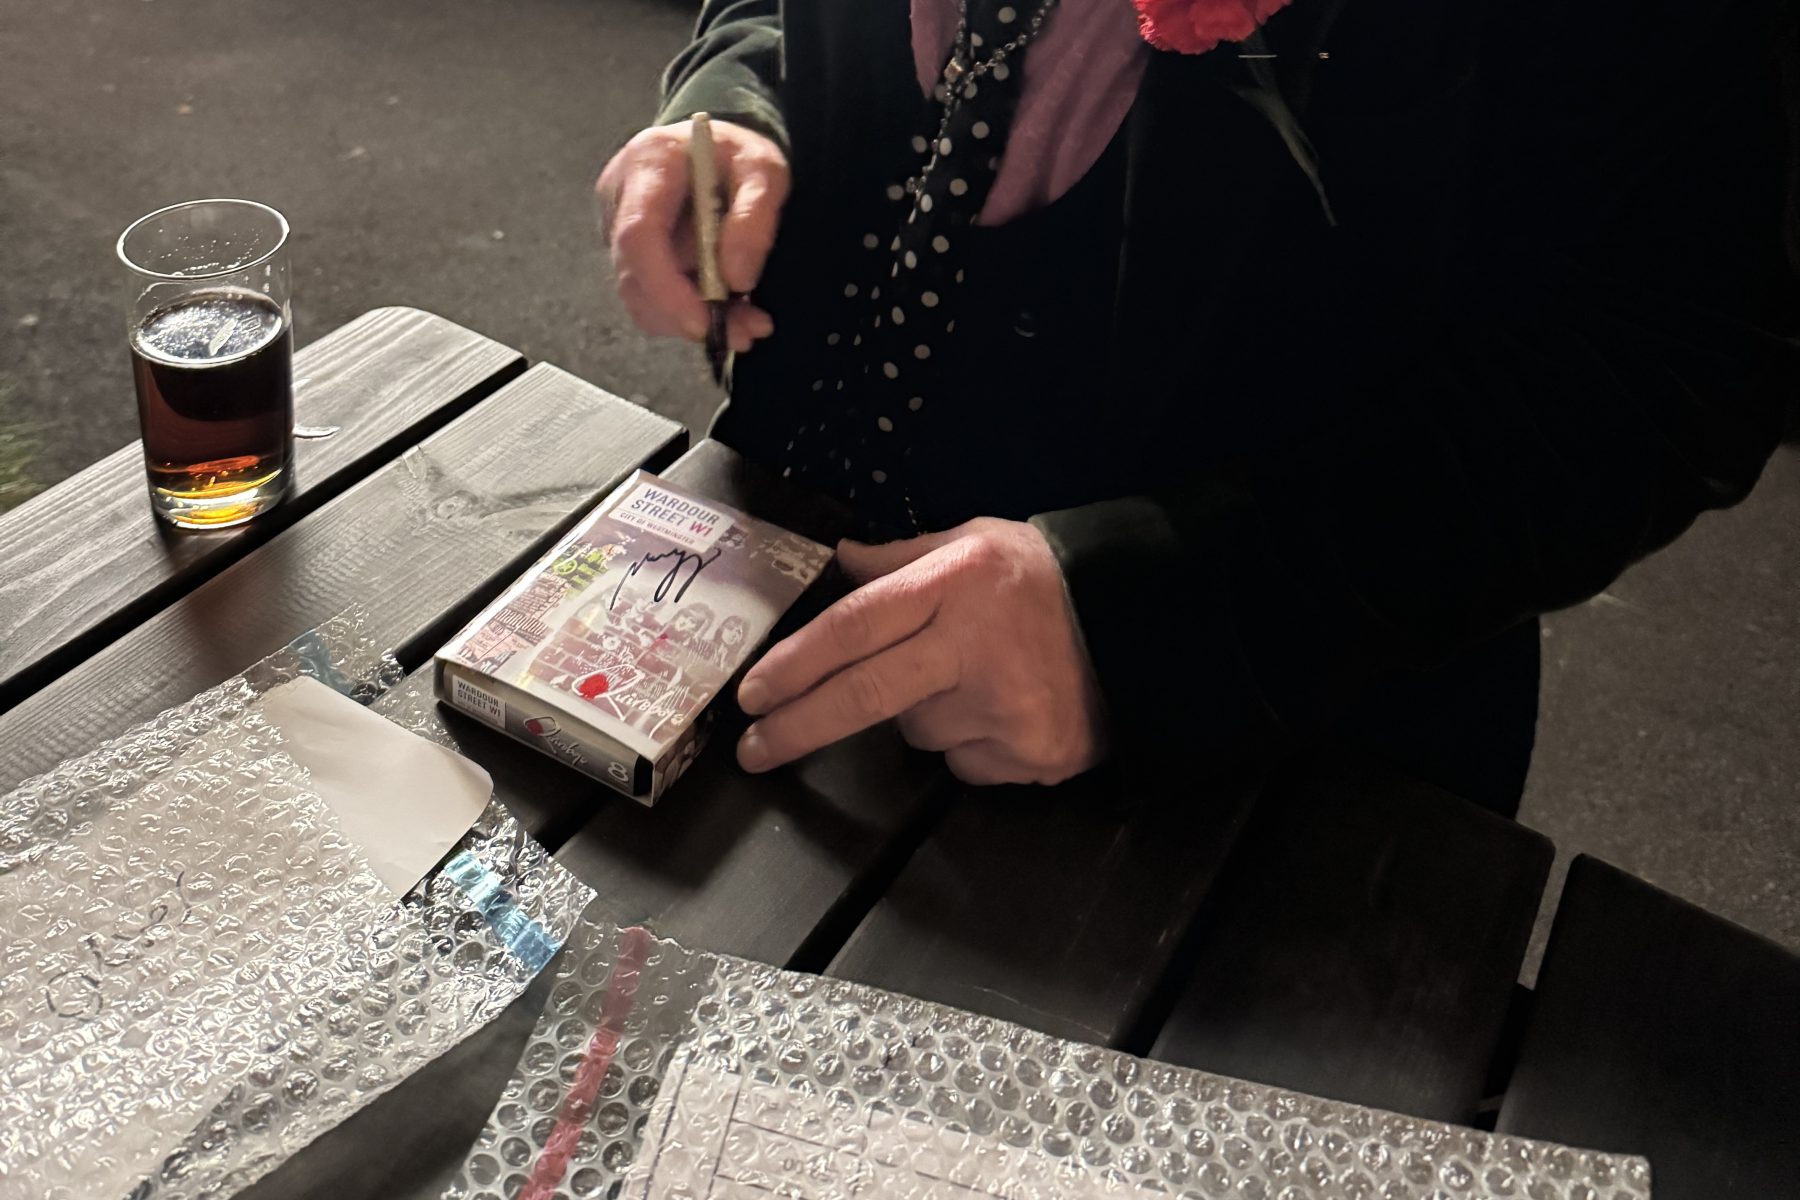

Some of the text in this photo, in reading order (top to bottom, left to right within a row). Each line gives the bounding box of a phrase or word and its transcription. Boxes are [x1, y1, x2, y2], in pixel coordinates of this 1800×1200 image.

[631, 499, 714, 538] STREET W1
[644, 487, 720, 525] WARDOUR
[457, 680, 499, 708] WARDOUR
[457, 689, 487, 710] STREET
